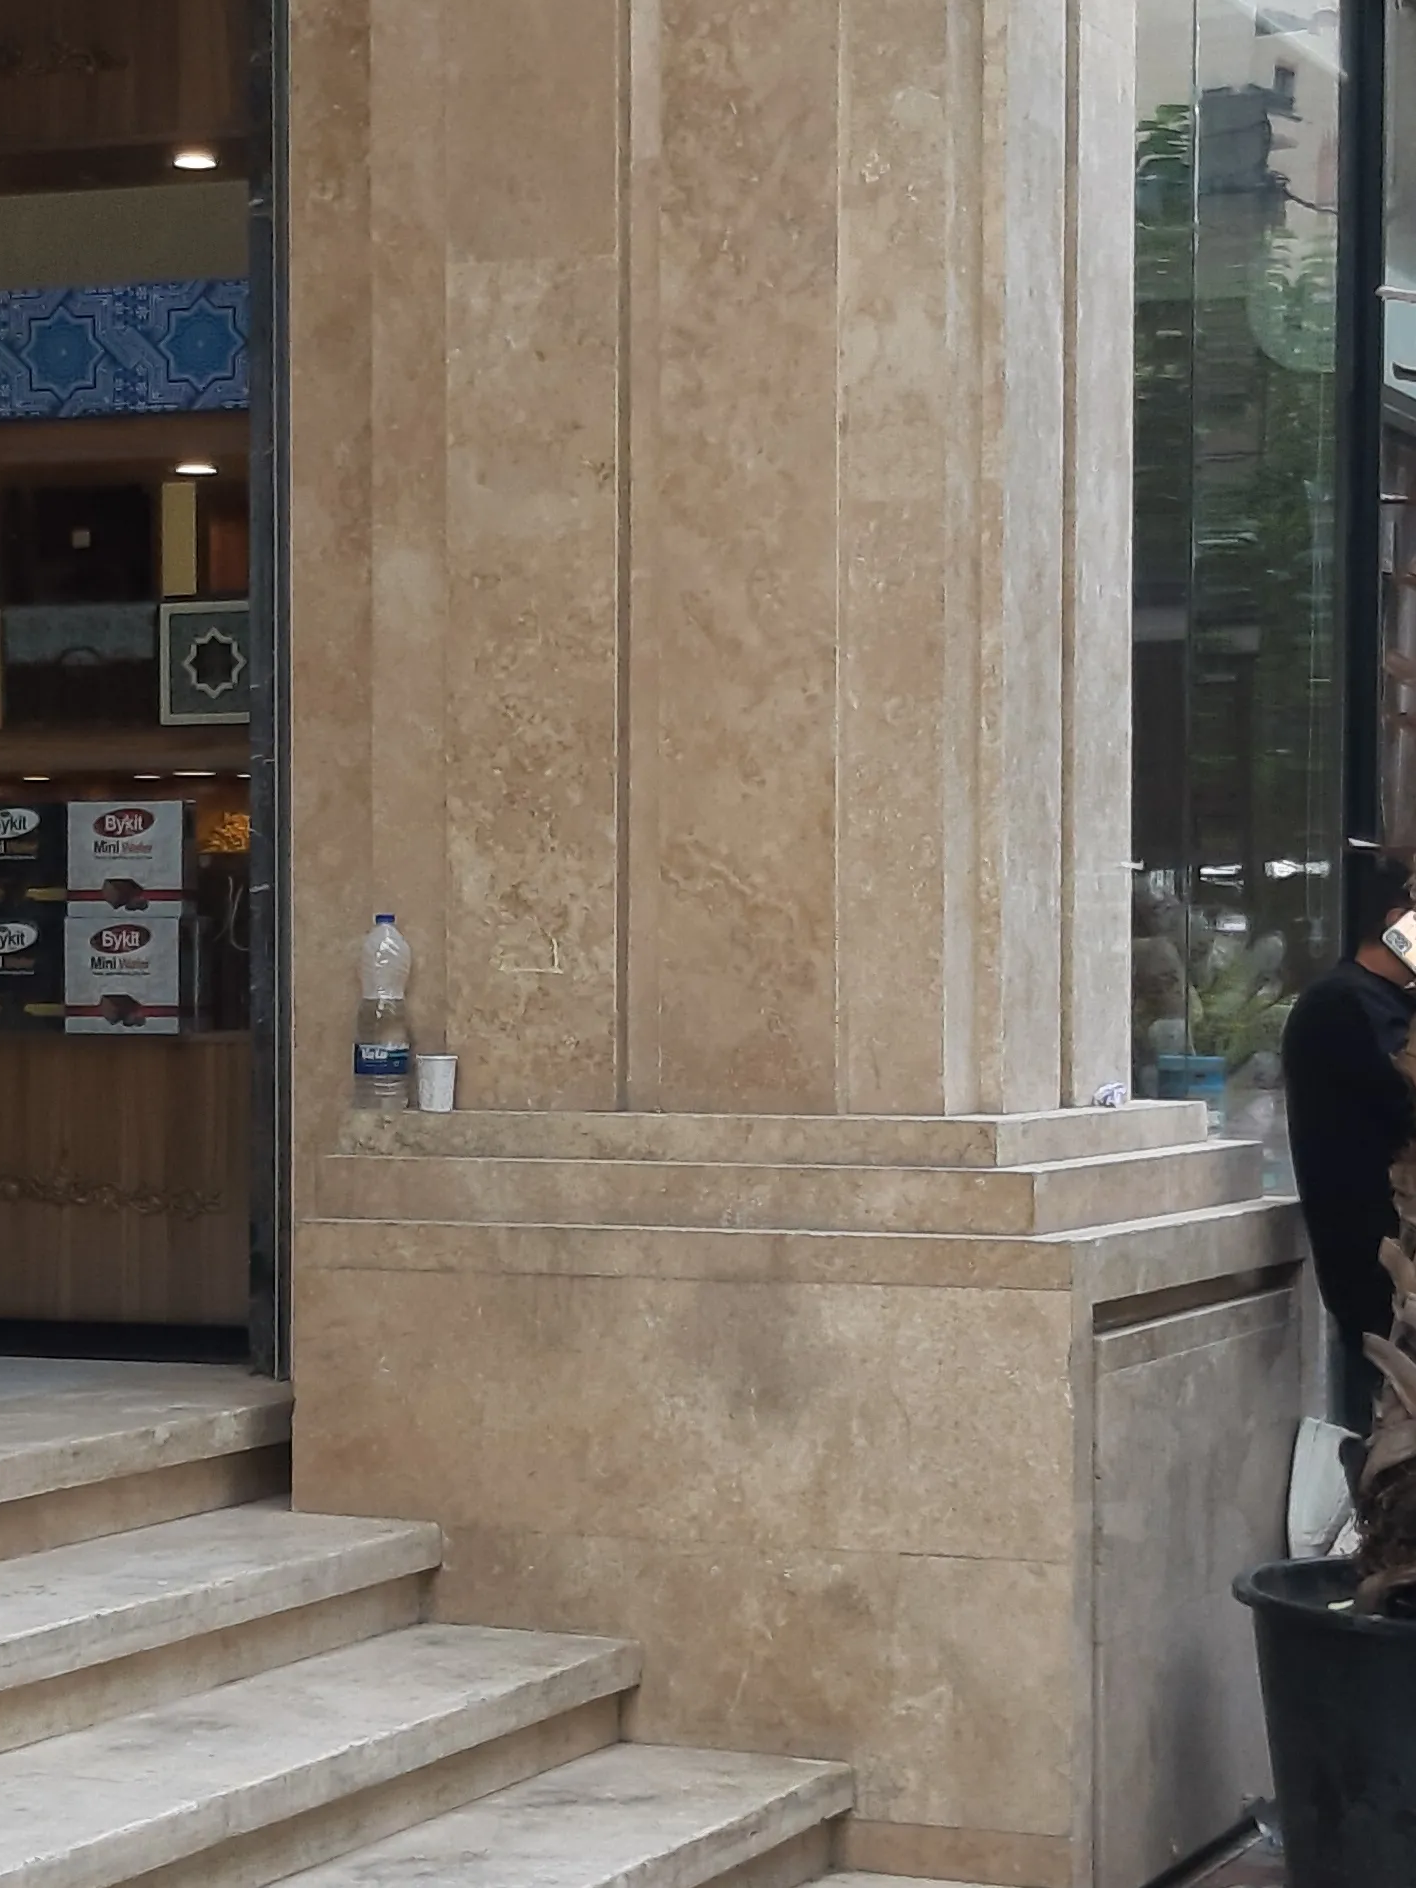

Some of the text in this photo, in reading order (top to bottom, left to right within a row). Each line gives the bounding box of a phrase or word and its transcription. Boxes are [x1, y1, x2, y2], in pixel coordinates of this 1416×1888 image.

[104, 814, 143, 836] Bykit
[93, 840, 119, 854] Mini
[102, 930, 140, 951] Bykit
[90, 956, 116, 969] Mini
